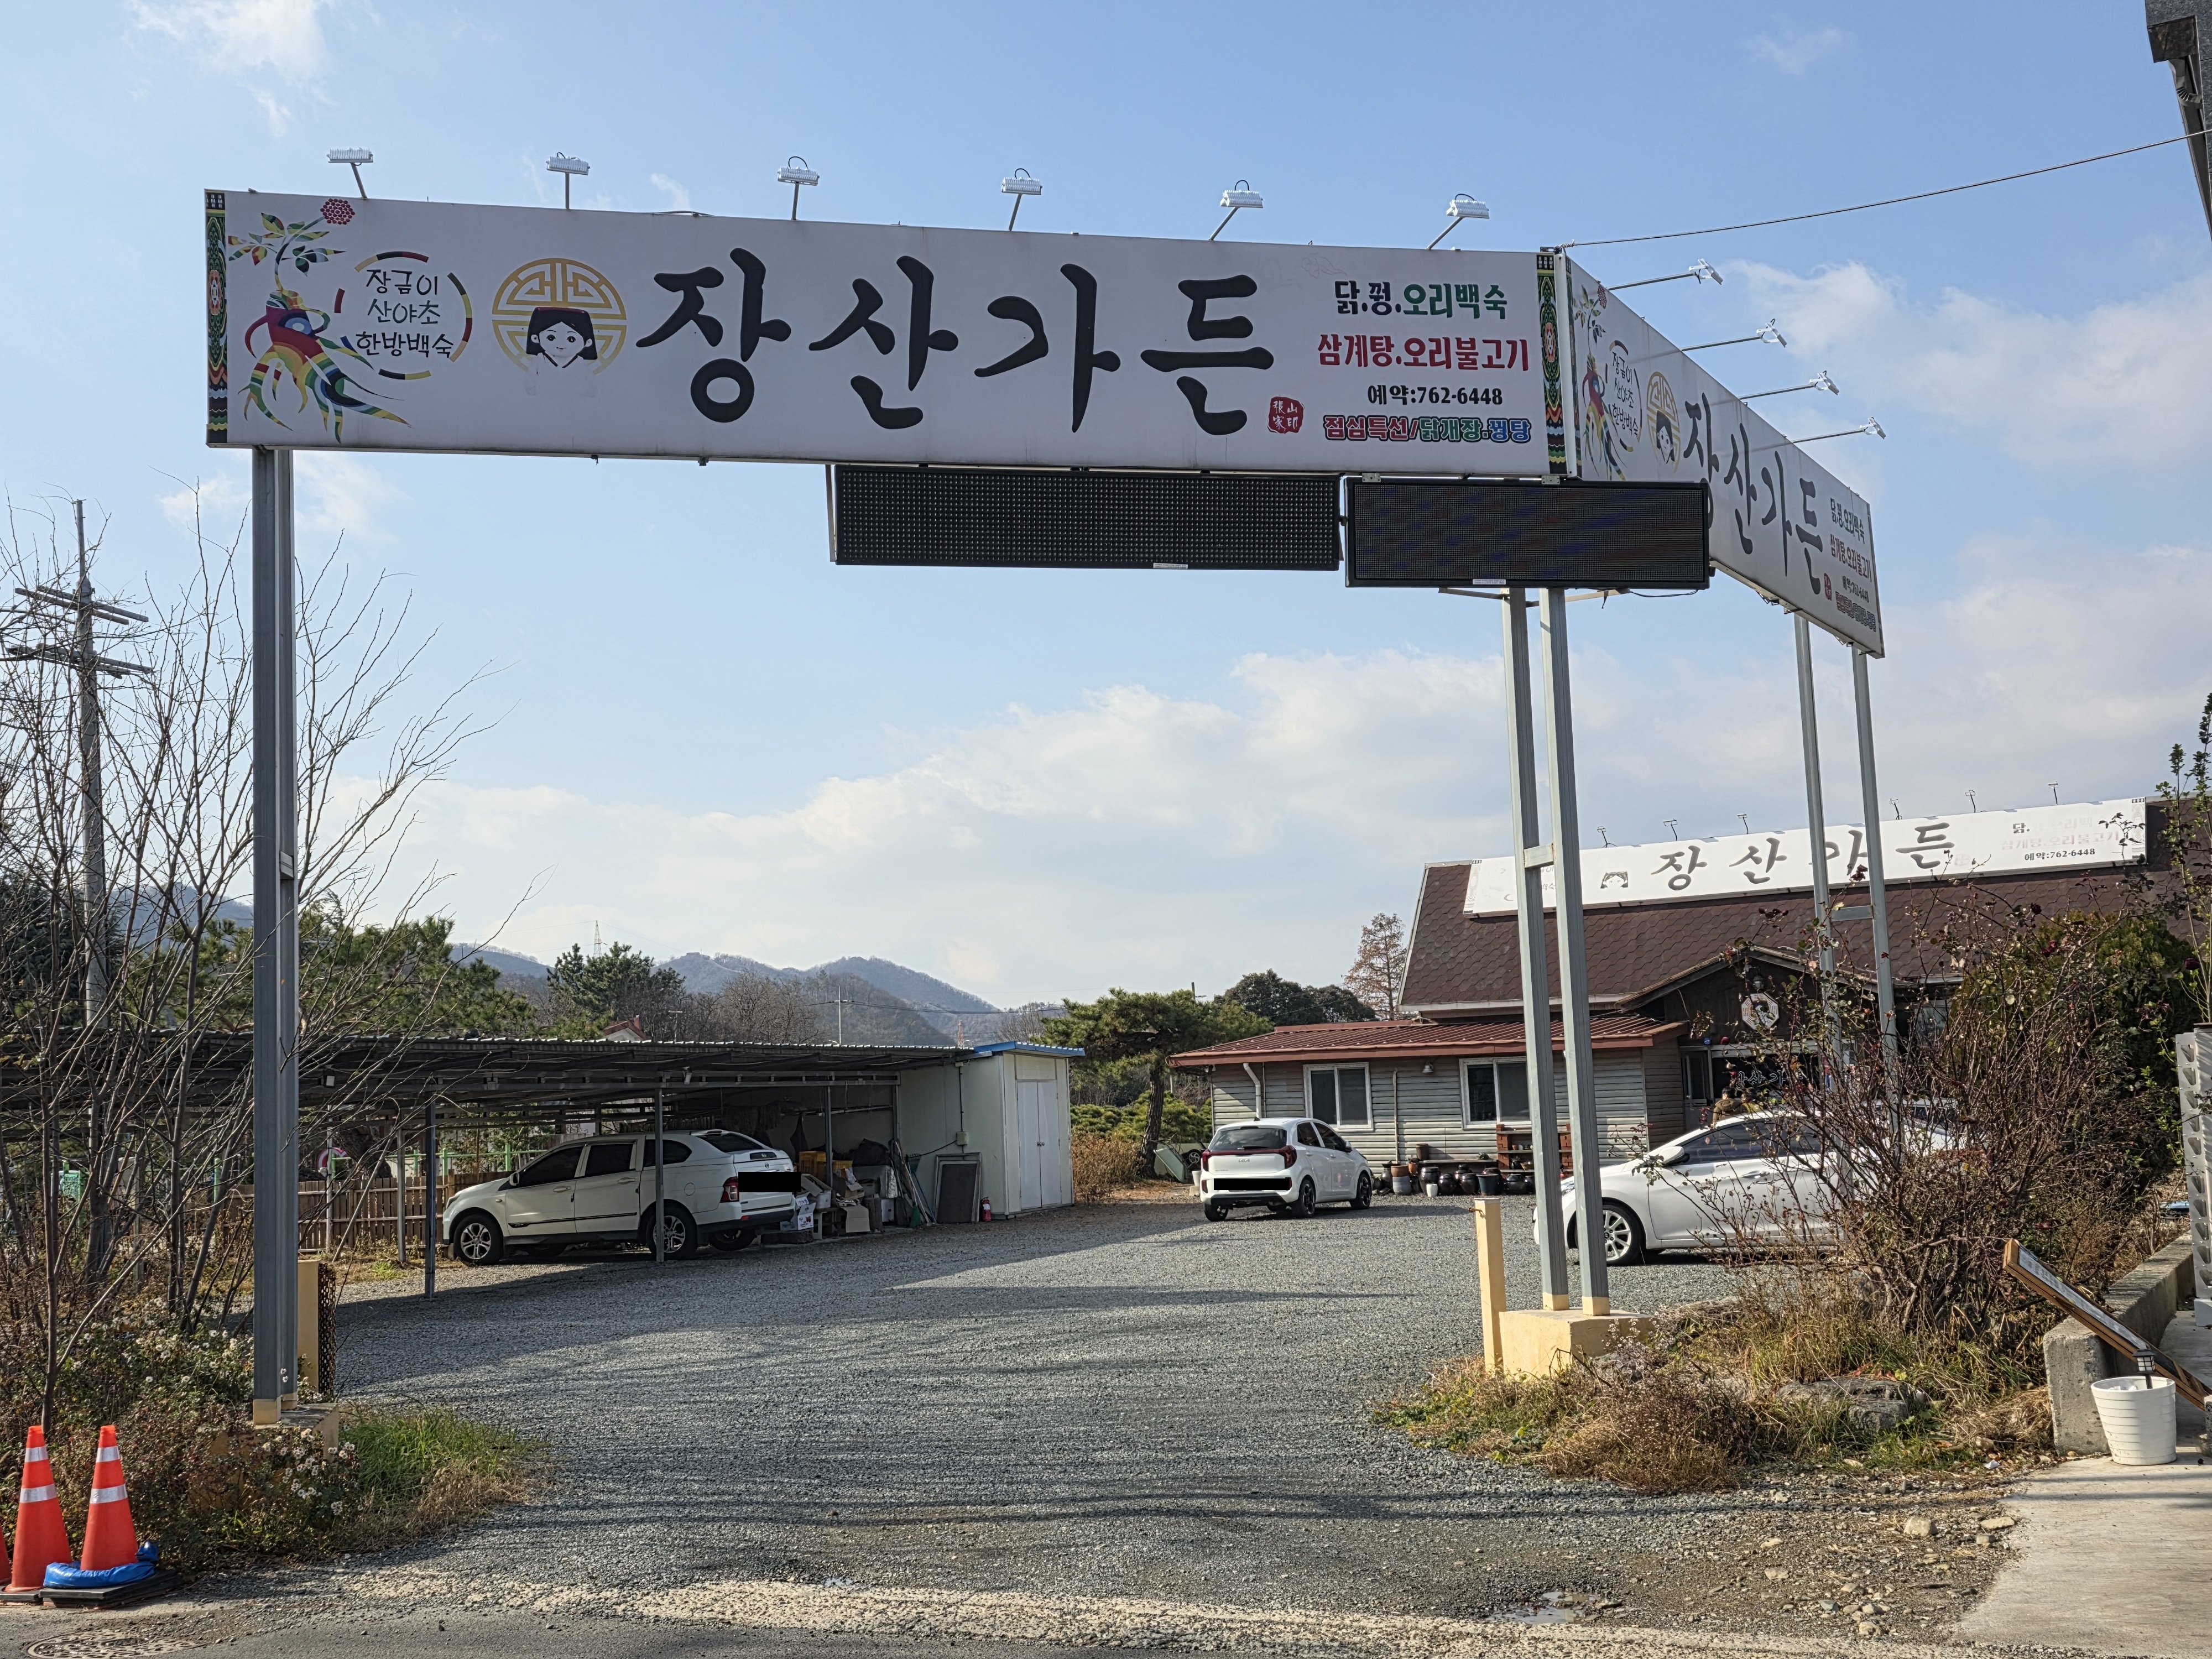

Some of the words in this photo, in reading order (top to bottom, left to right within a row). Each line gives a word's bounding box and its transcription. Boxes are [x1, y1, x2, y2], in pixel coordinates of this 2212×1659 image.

[366, 269, 438, 295] 장금이
[367, 298, 441, 325] 산야초
[356, 331, 454, 359] 한방백숙
[635, 247, 1274, 436] 장산가든
[1612, 351, 1632, 385] 장금이
[1614, 377, 1634, 409] 산야초
[1612, 403, 1639, 440] 한방백숙
